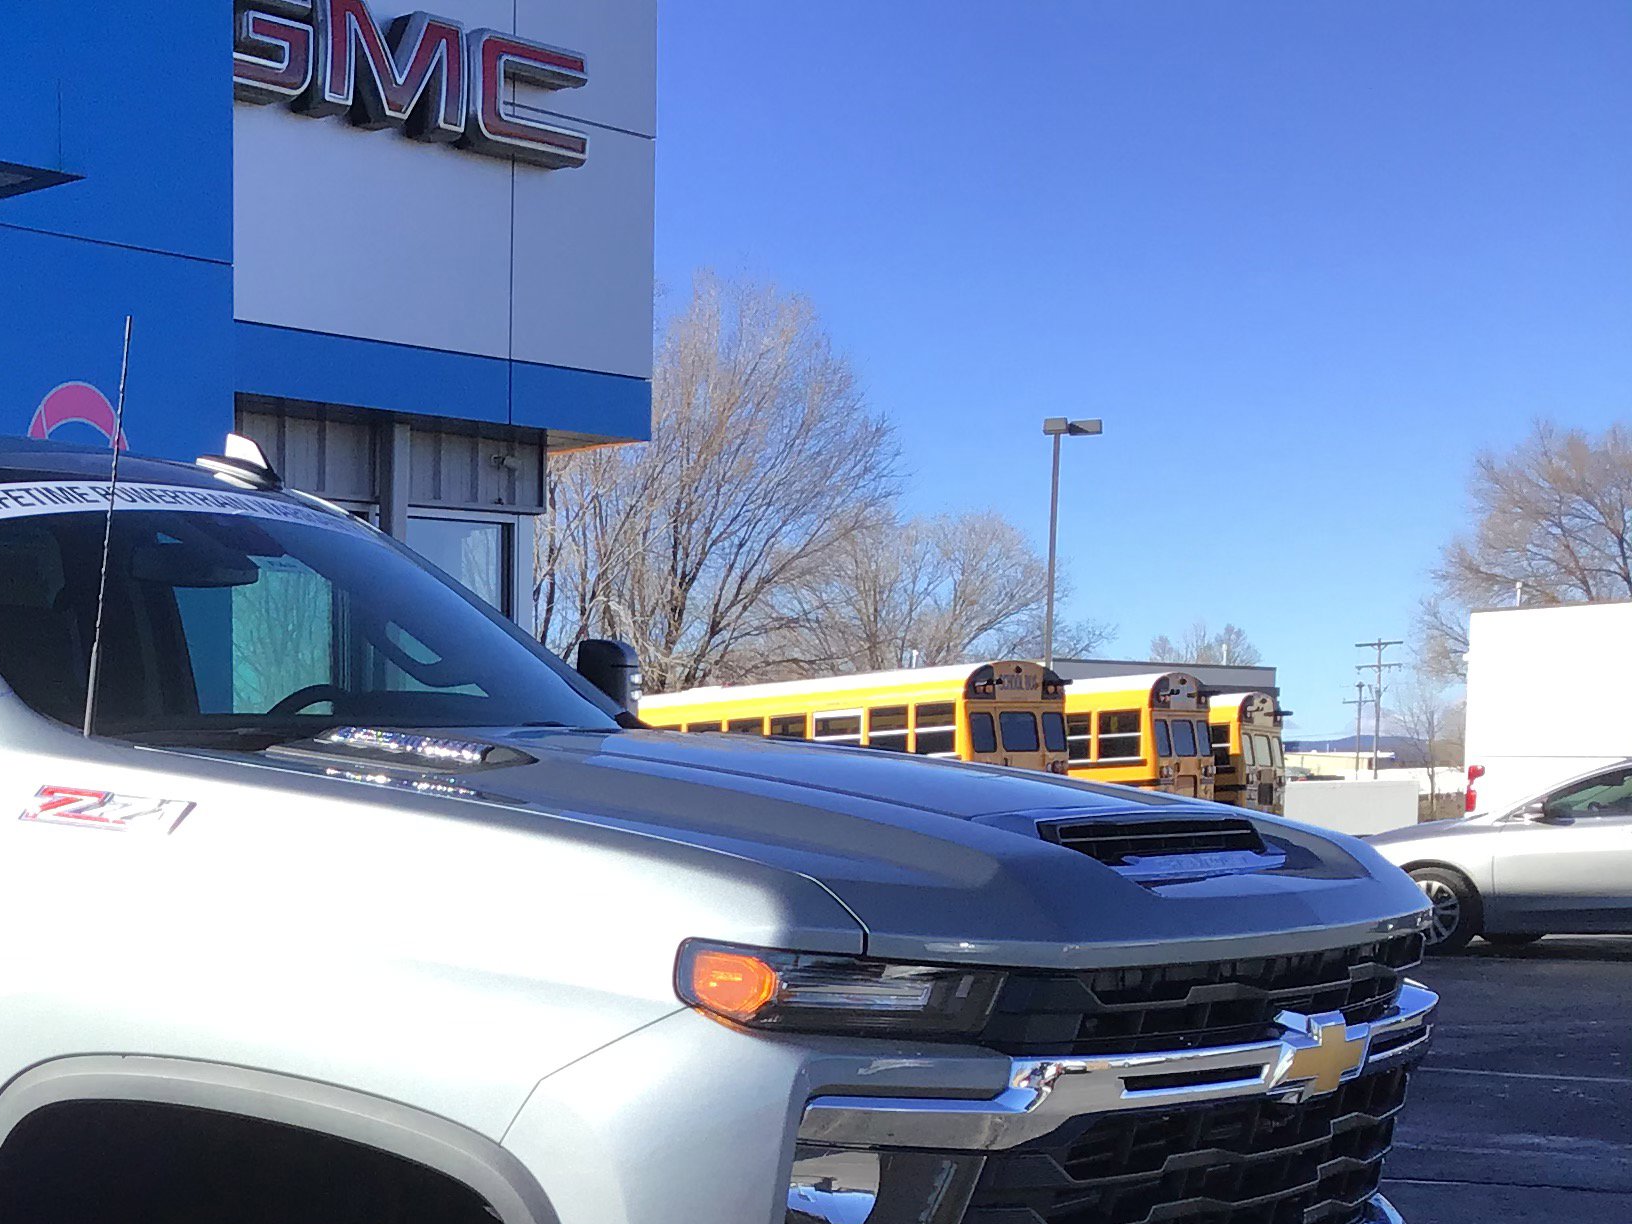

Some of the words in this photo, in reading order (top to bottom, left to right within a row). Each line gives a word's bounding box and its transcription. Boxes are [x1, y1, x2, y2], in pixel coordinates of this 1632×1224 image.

[233, 0, 590, 162] GMC
[88, 486, 258, 512] POWERTRAIN
[19, 785, 197, 835] Z71
